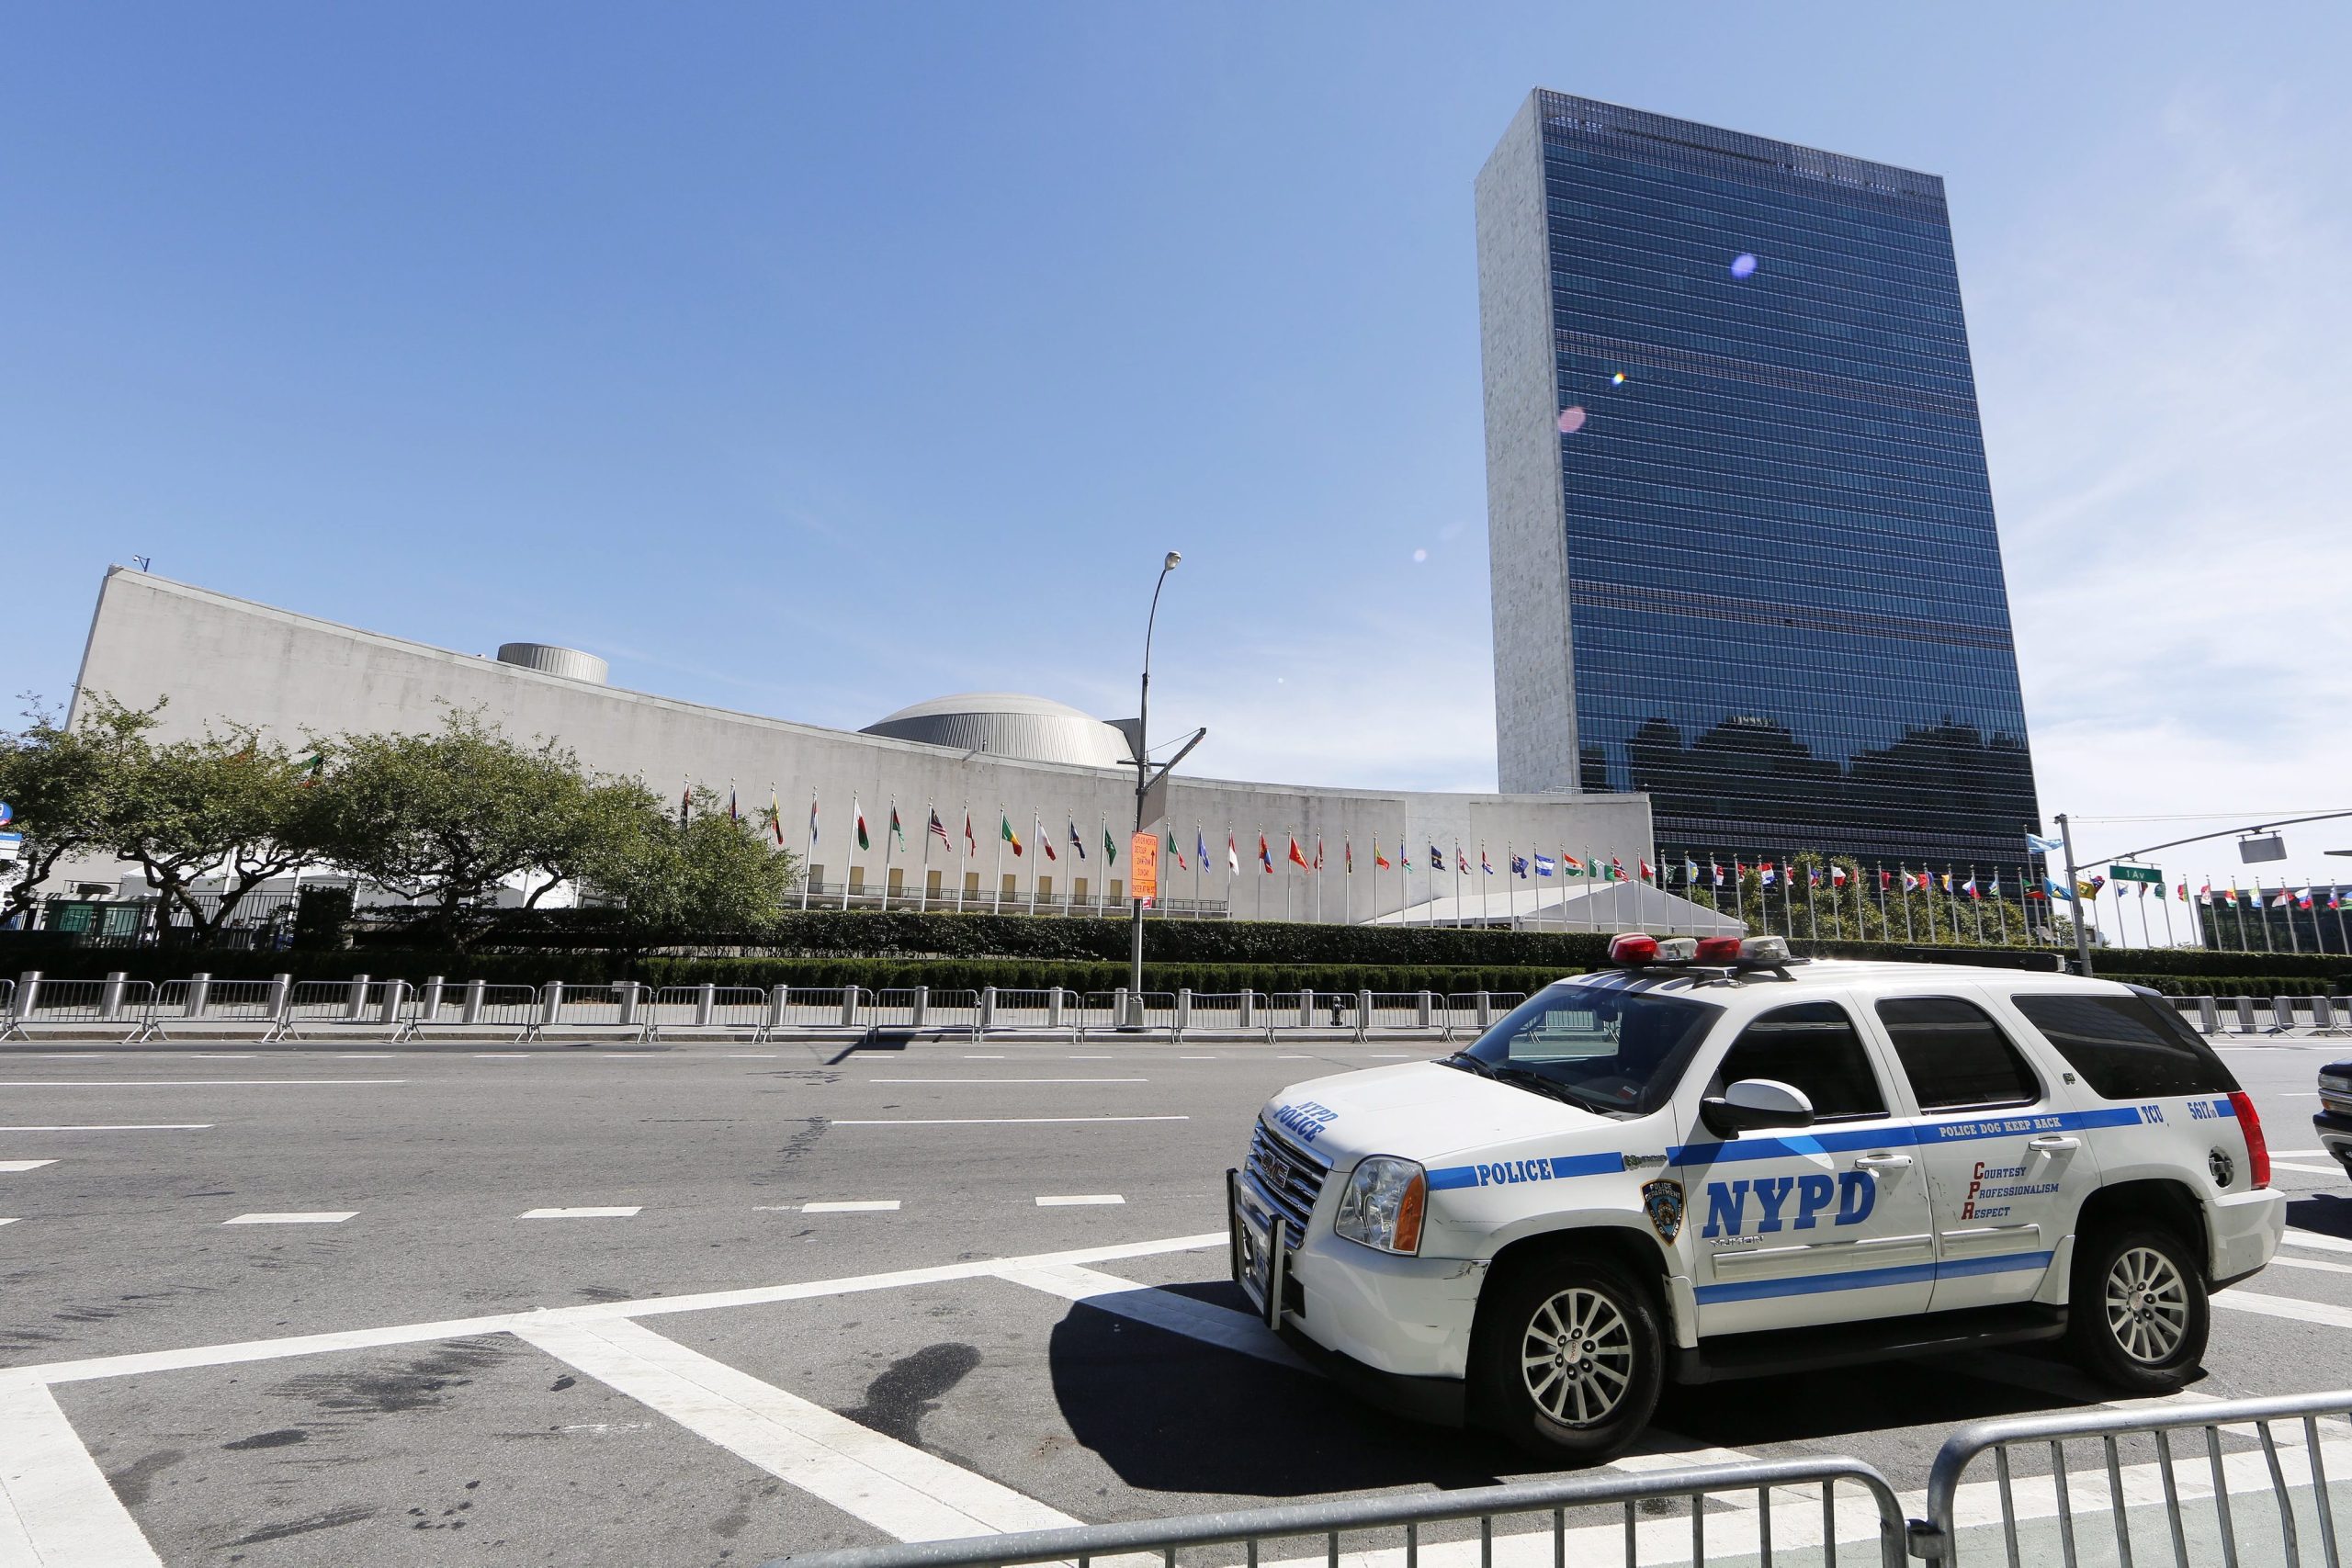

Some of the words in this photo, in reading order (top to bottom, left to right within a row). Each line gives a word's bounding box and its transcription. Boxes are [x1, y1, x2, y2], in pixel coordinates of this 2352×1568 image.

[1295, 1100, 1339, 1122] NYPD
[2141, 1105, 2164, 1123] TCU
[2187, 1101, 2211, 1120] 5617
[1272, 1104, 1326, 1143] POLICE
[1939, 1124, 1977, 1138] POLICE
[1979, 1122, 2002, 1134] DOG
[2003, 1120, 2031, 1132] KEEP
[2033, 1117, 2062, 1129] BACK
[1476, 1158, 1552, 1187] POLICE
[1973, 1161, 2027, 1180] COURTESY
[1645, 1189, 1681, 1201] DEPARTMENT
[1649, 1182, 1672, 1190] POLICE
[1967, 1181, 2059, 1200] PROFESSIONALISM
[1702, 1170, 1876, 1239] NYPD
[1961, 1201, 2011, 1221] RESPECT
[1658, 1226, 1666, 1235] OF
[1710, 1235, 1765, 1247] YUKON
